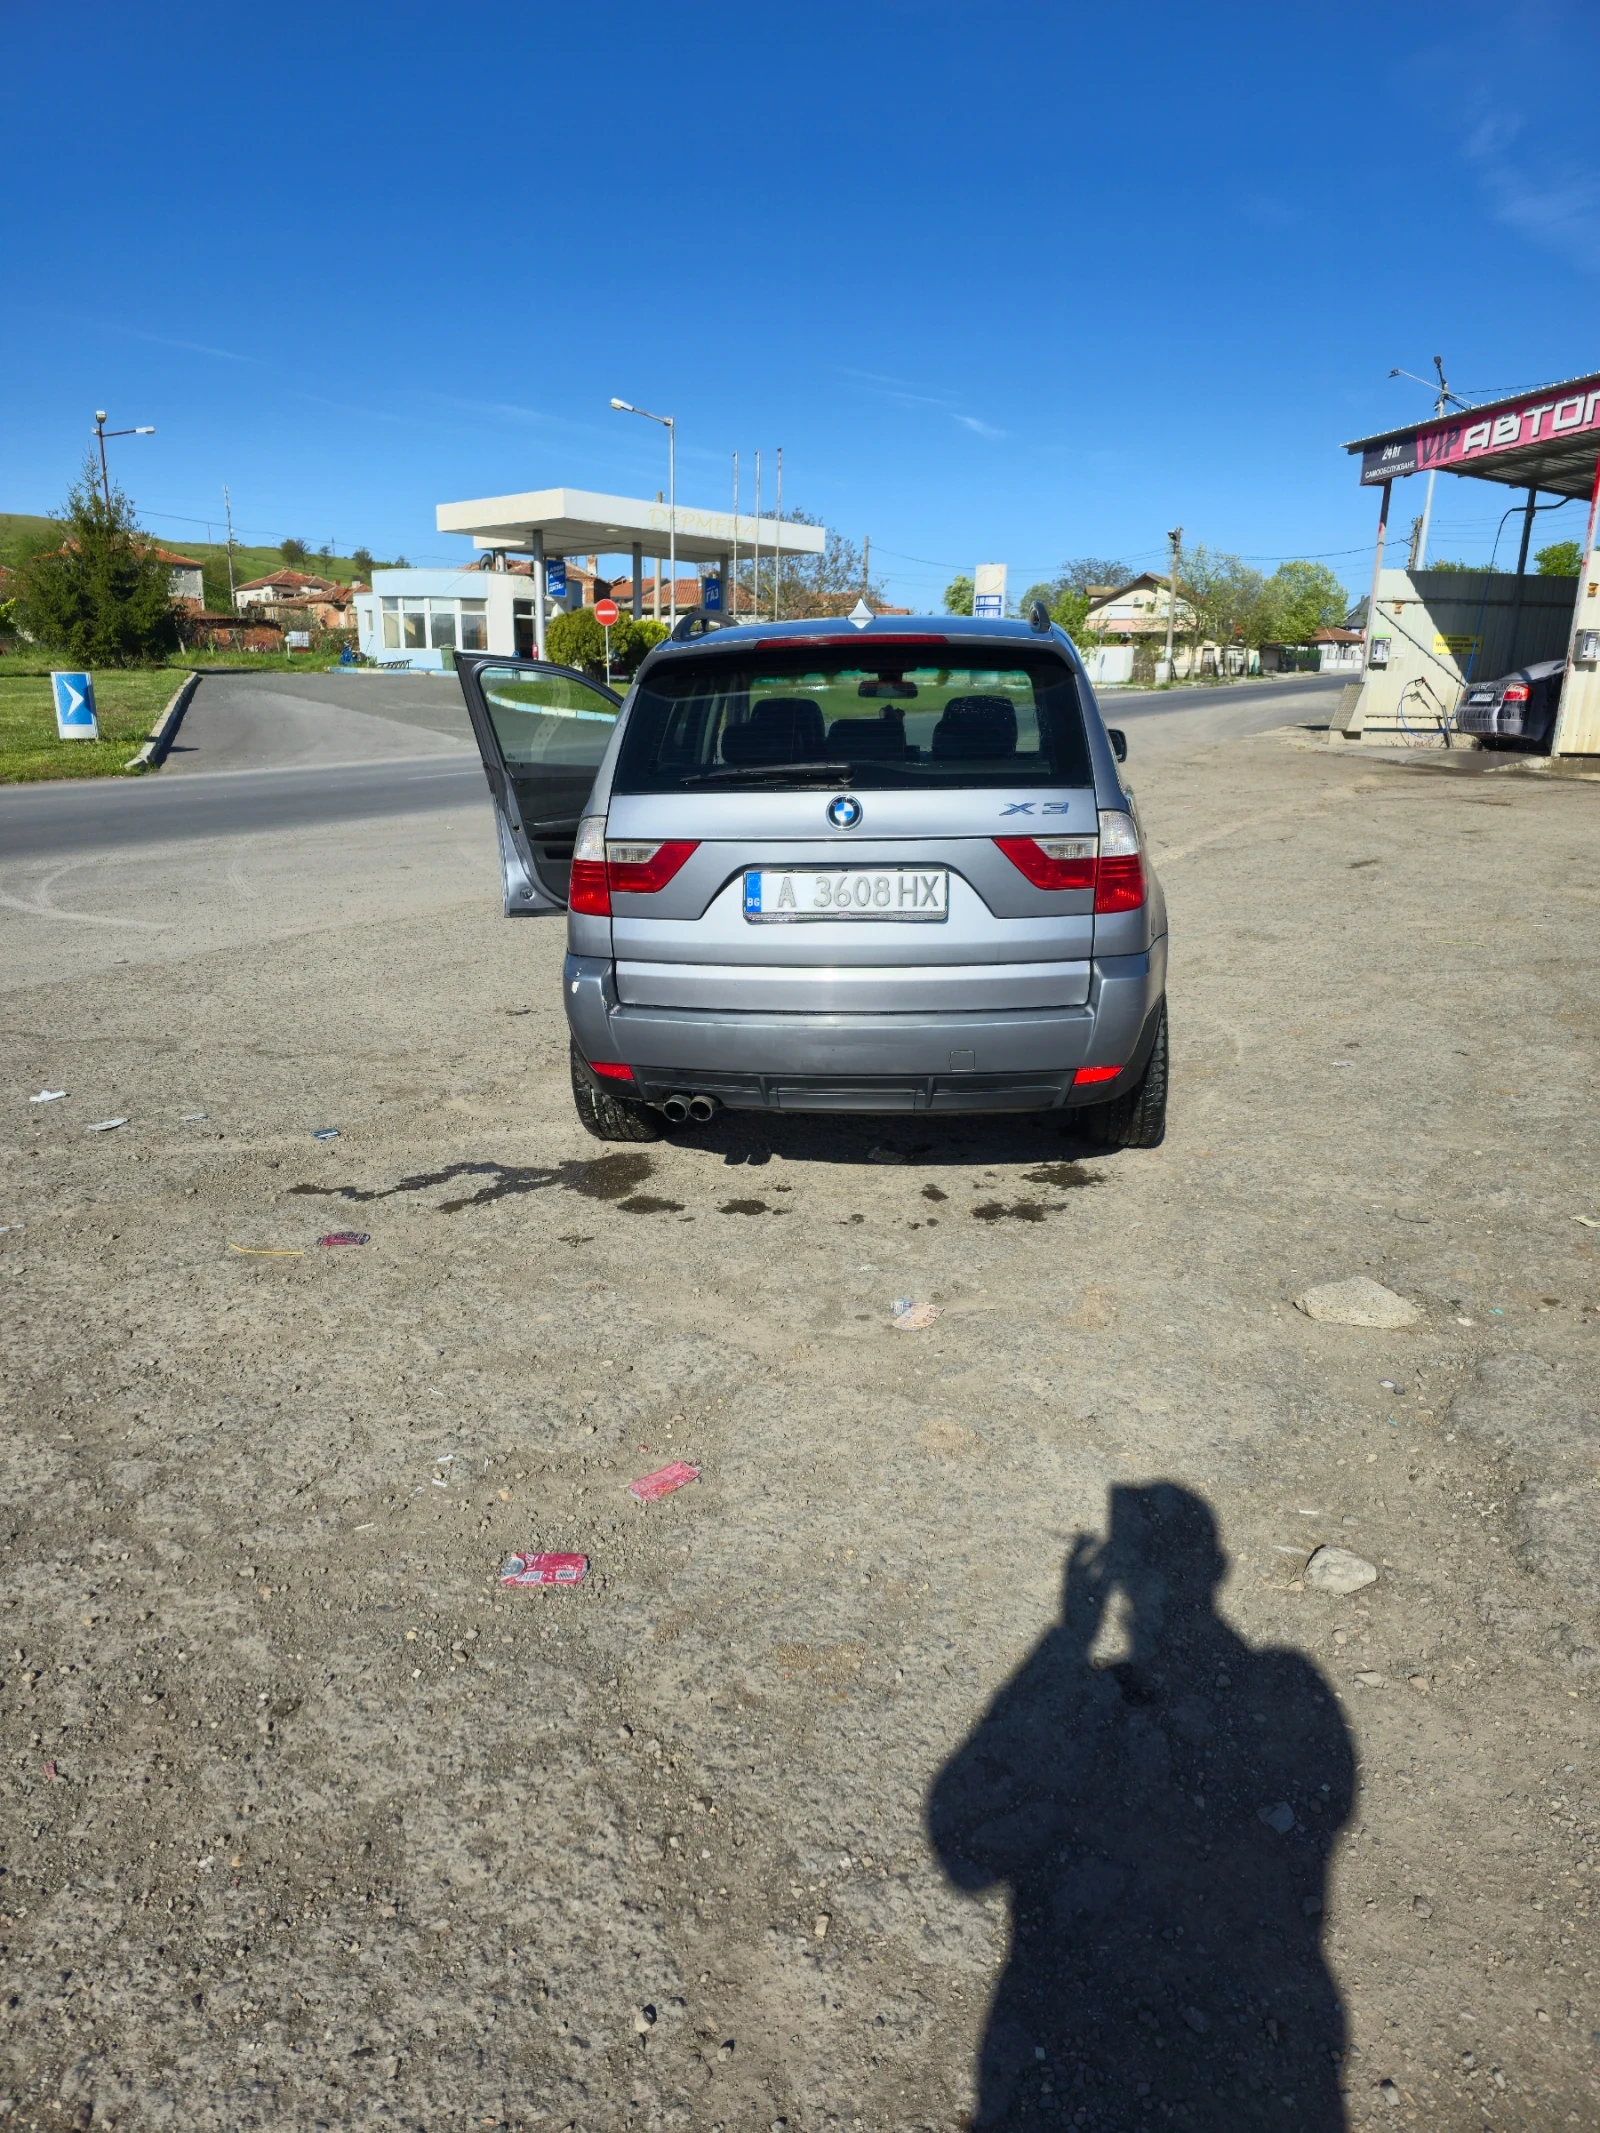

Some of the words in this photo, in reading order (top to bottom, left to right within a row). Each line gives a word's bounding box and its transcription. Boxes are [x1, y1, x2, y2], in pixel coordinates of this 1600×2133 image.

[1421, 426, 1461, 464] VIP
[706, 587, 719, 603] ГАЗ
[998, 801, 1069, 817] X3
[777, 877, 797, 908] A
[813, 876, 890, 907] 3608
[747, 898, 760, 907] BG
